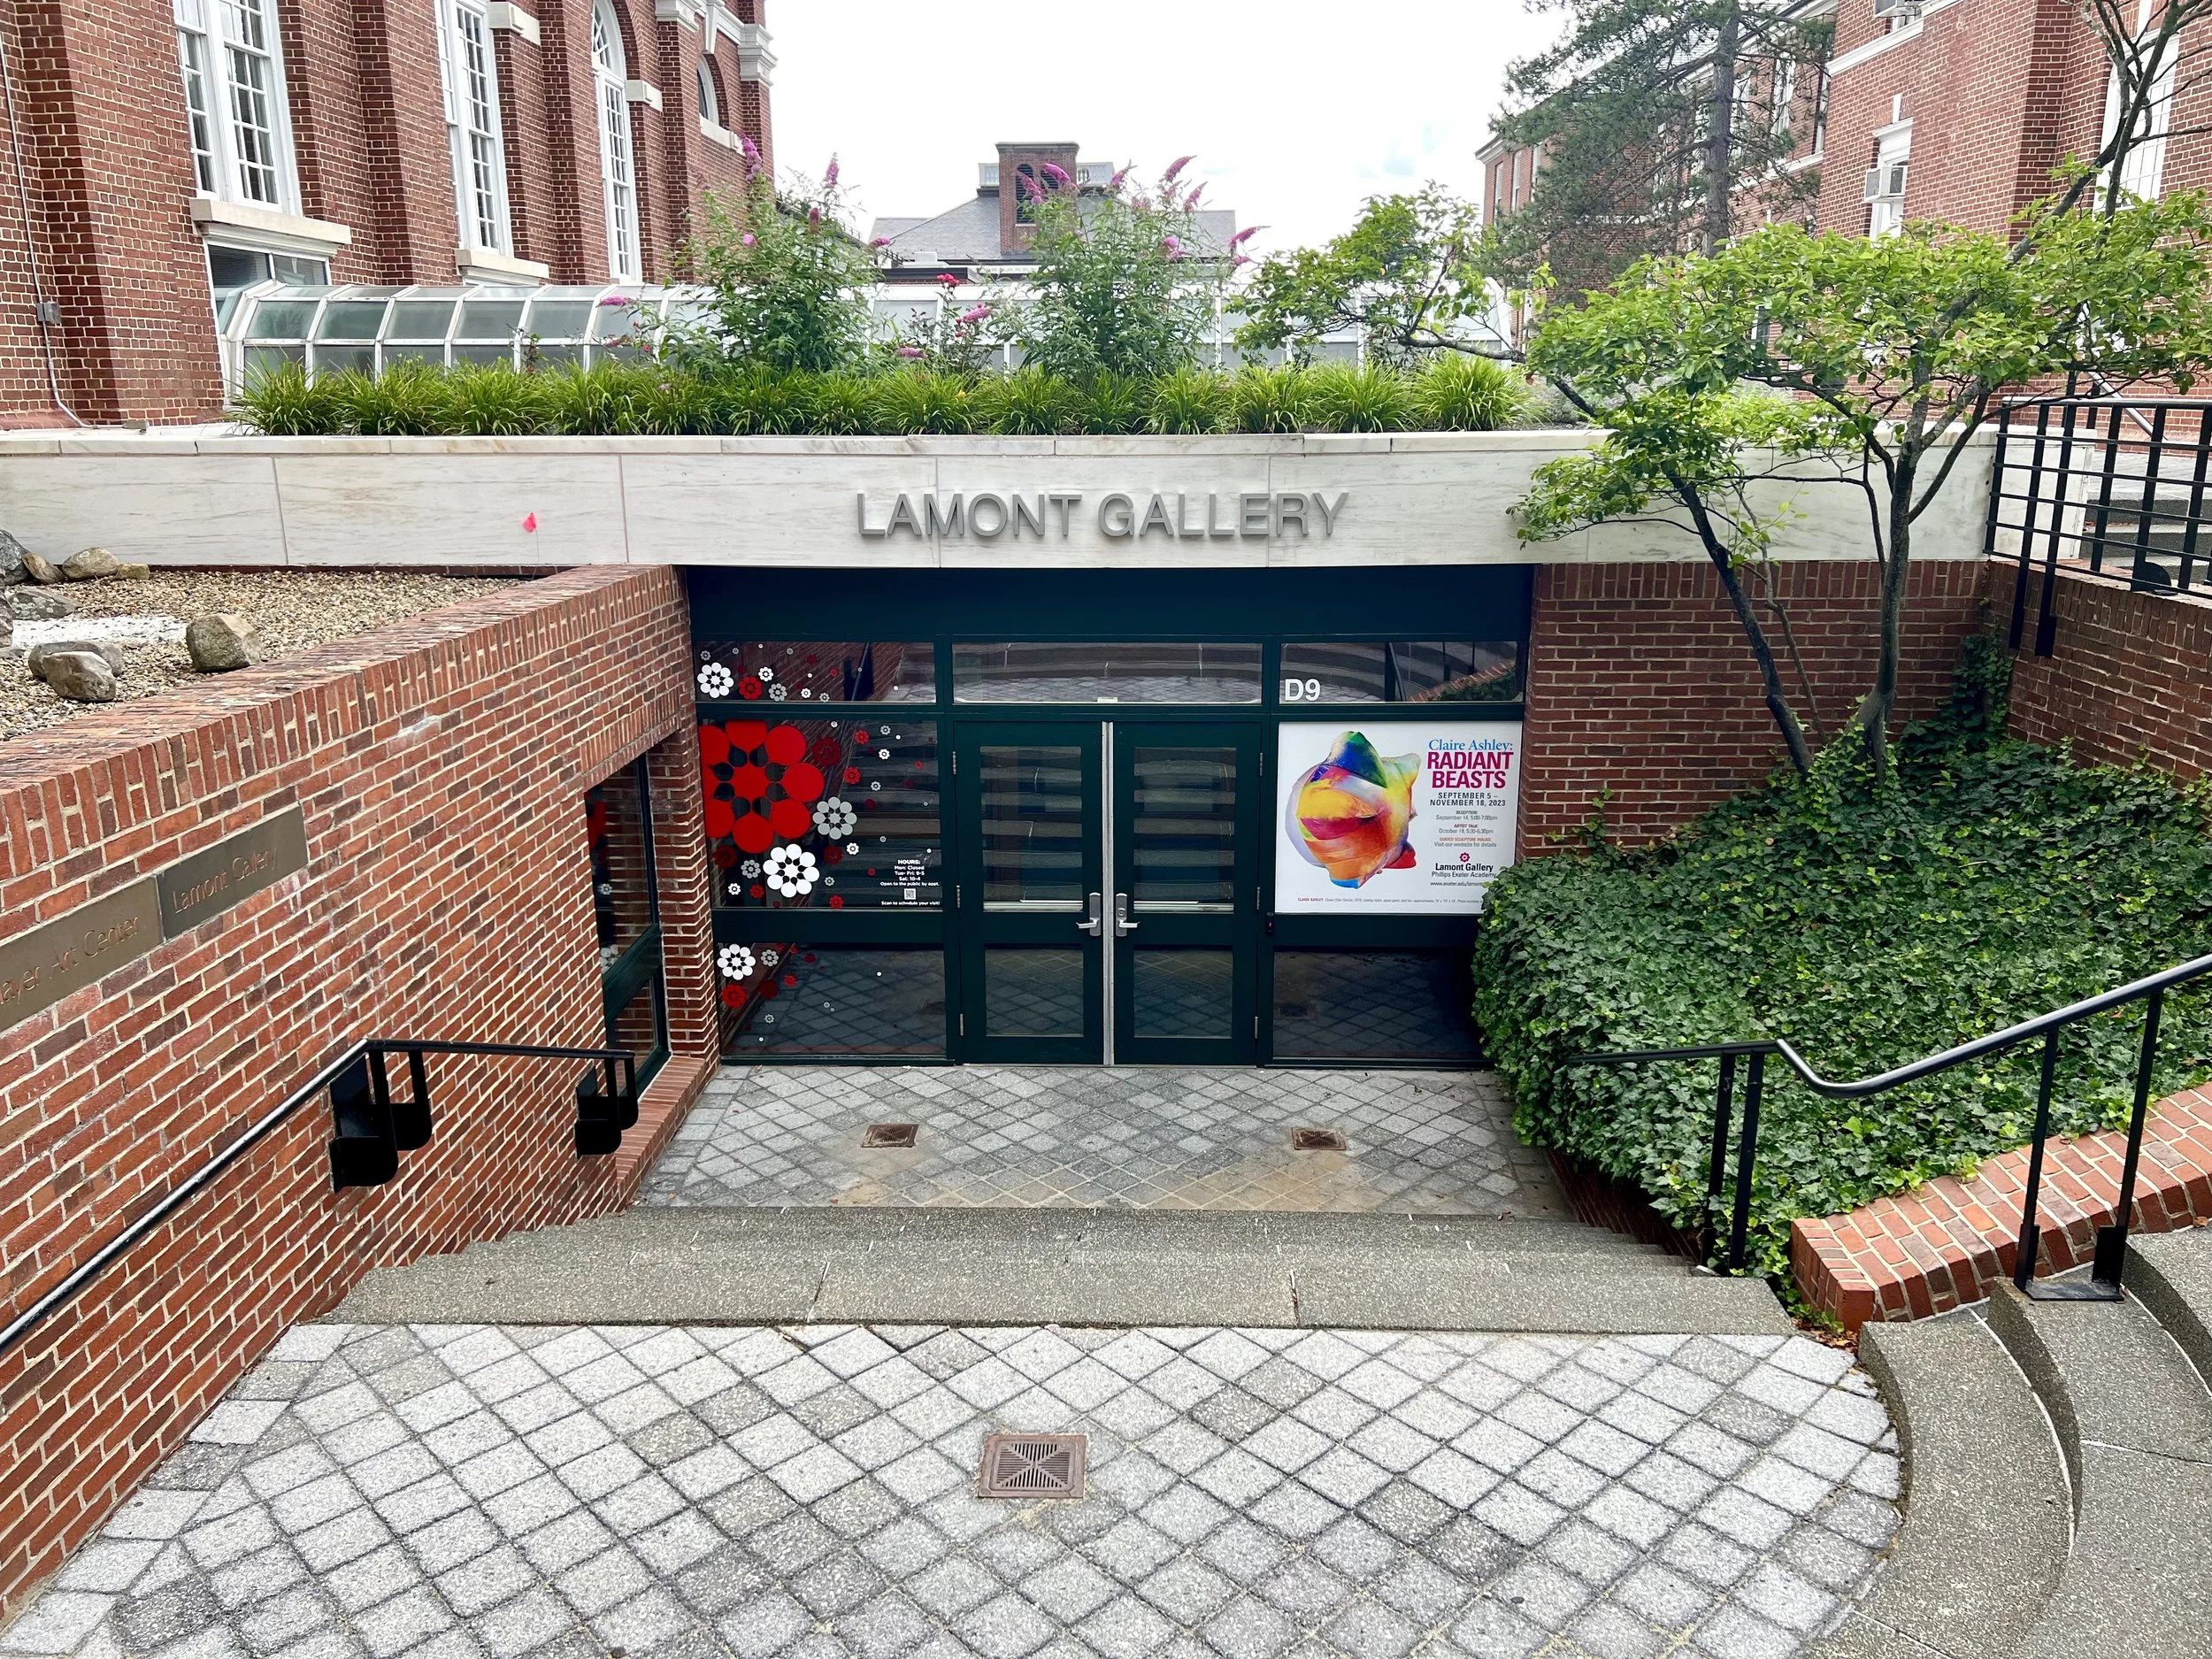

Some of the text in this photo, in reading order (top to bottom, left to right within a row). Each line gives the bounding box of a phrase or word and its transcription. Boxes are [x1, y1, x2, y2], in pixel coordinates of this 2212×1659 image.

[856, 492, 1349, 537] LAMONT GALLERY
[1285, 678, 1321, 702] D9
[1428, 739, 1513, 752] Claire Ashley:
[1427, 751, 1514, 770] RADIANT
[1432, 771, 1506, 788] BEASTS
[1465, 863, 1494, 872] Gallery
[173, 847, 277, 914] Lamont Gallery
[0, 917, 139, 1005] ayer Art Center
